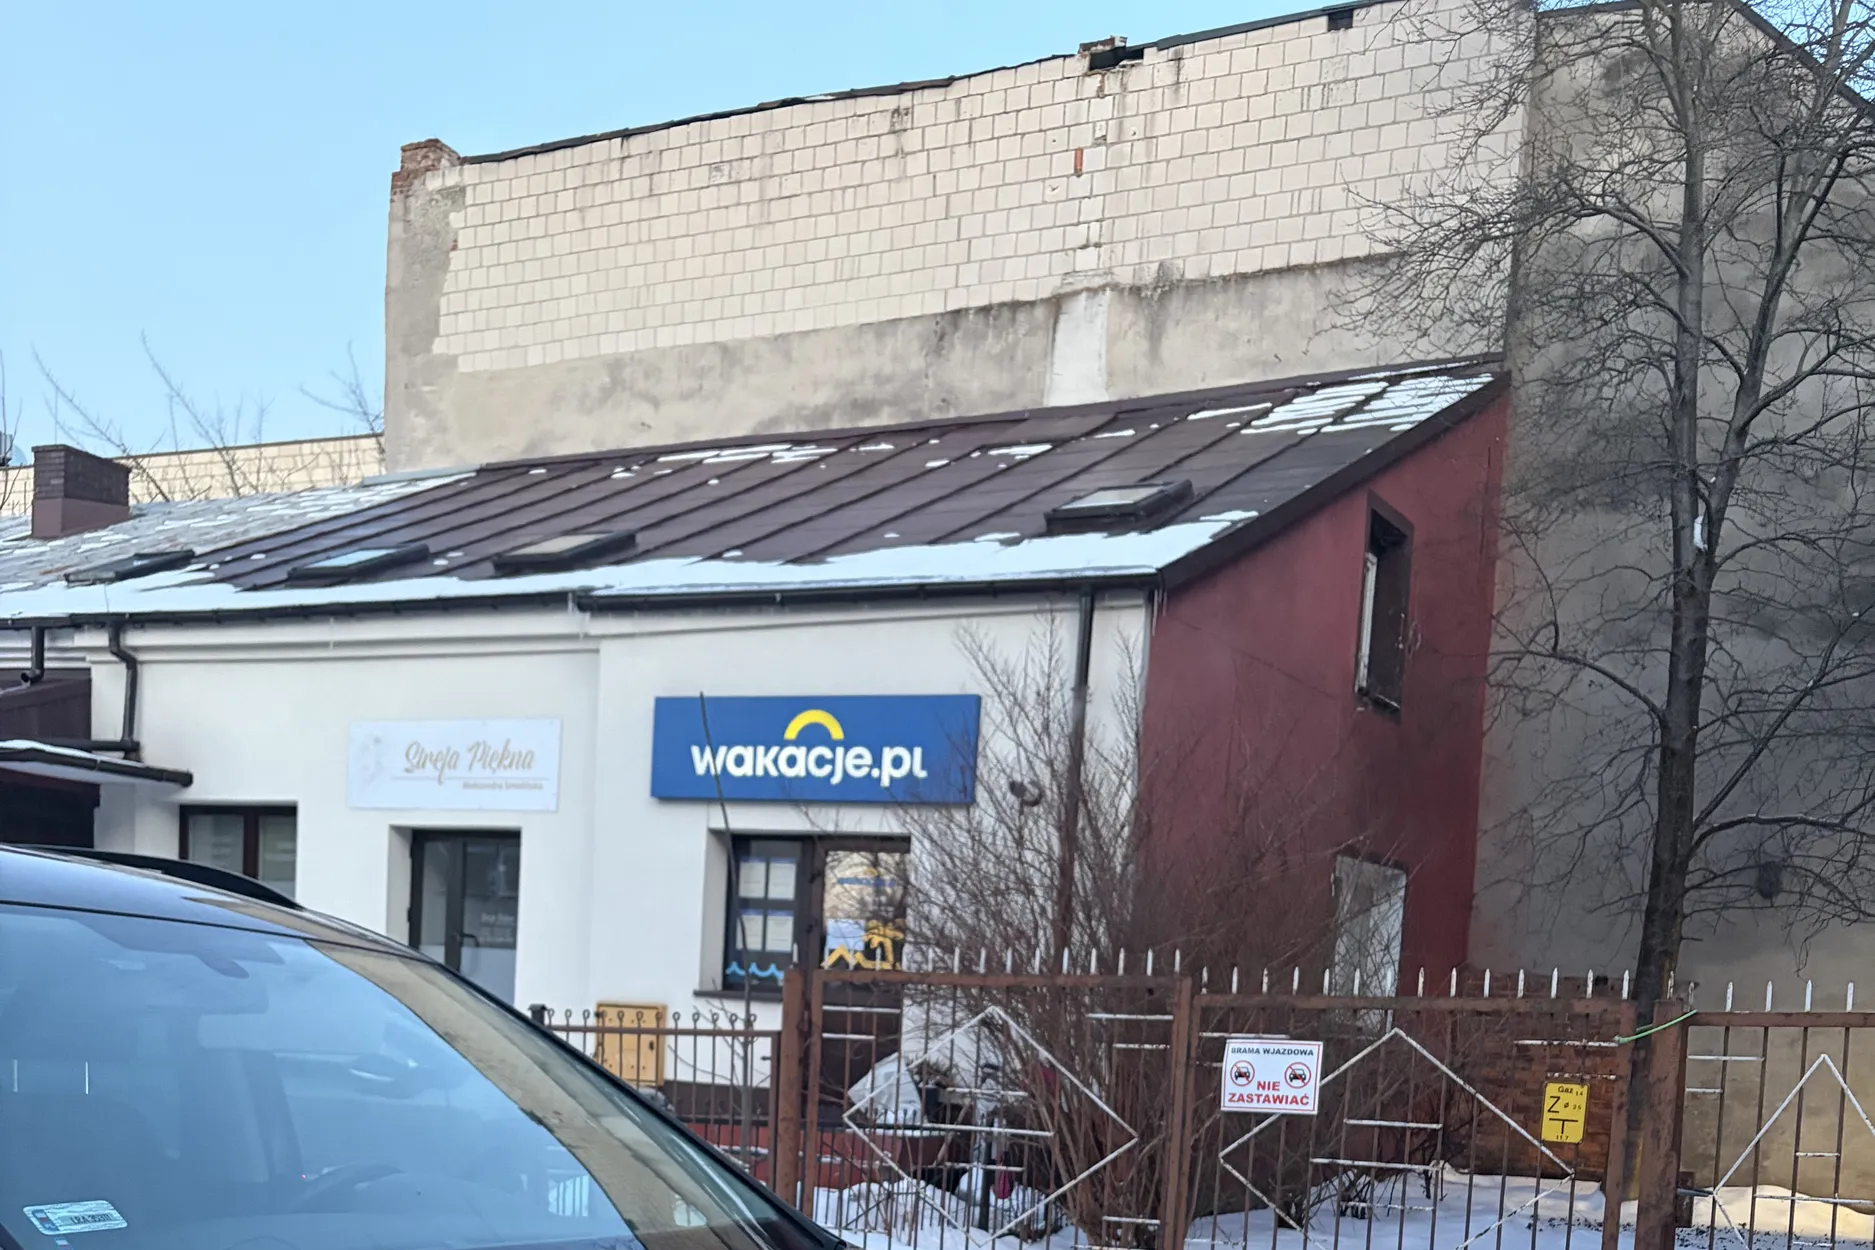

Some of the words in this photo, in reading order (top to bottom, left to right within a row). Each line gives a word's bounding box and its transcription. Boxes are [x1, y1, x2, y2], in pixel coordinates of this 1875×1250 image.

[690, 745, 928, 787] wakacje.pl
[1231, 1047, 1260, 1055] BRAMA
[1263, 1048, 1314, 1056] WJAZDOWA
[1256, 1081, 1281, 1091] NIE
[1558, 1086, 1573, 1094] Gaz
[1228, 1093, 1309, 1106] ZASTAWIAĆ
[1547, 1096, 1561, 1114] Z
